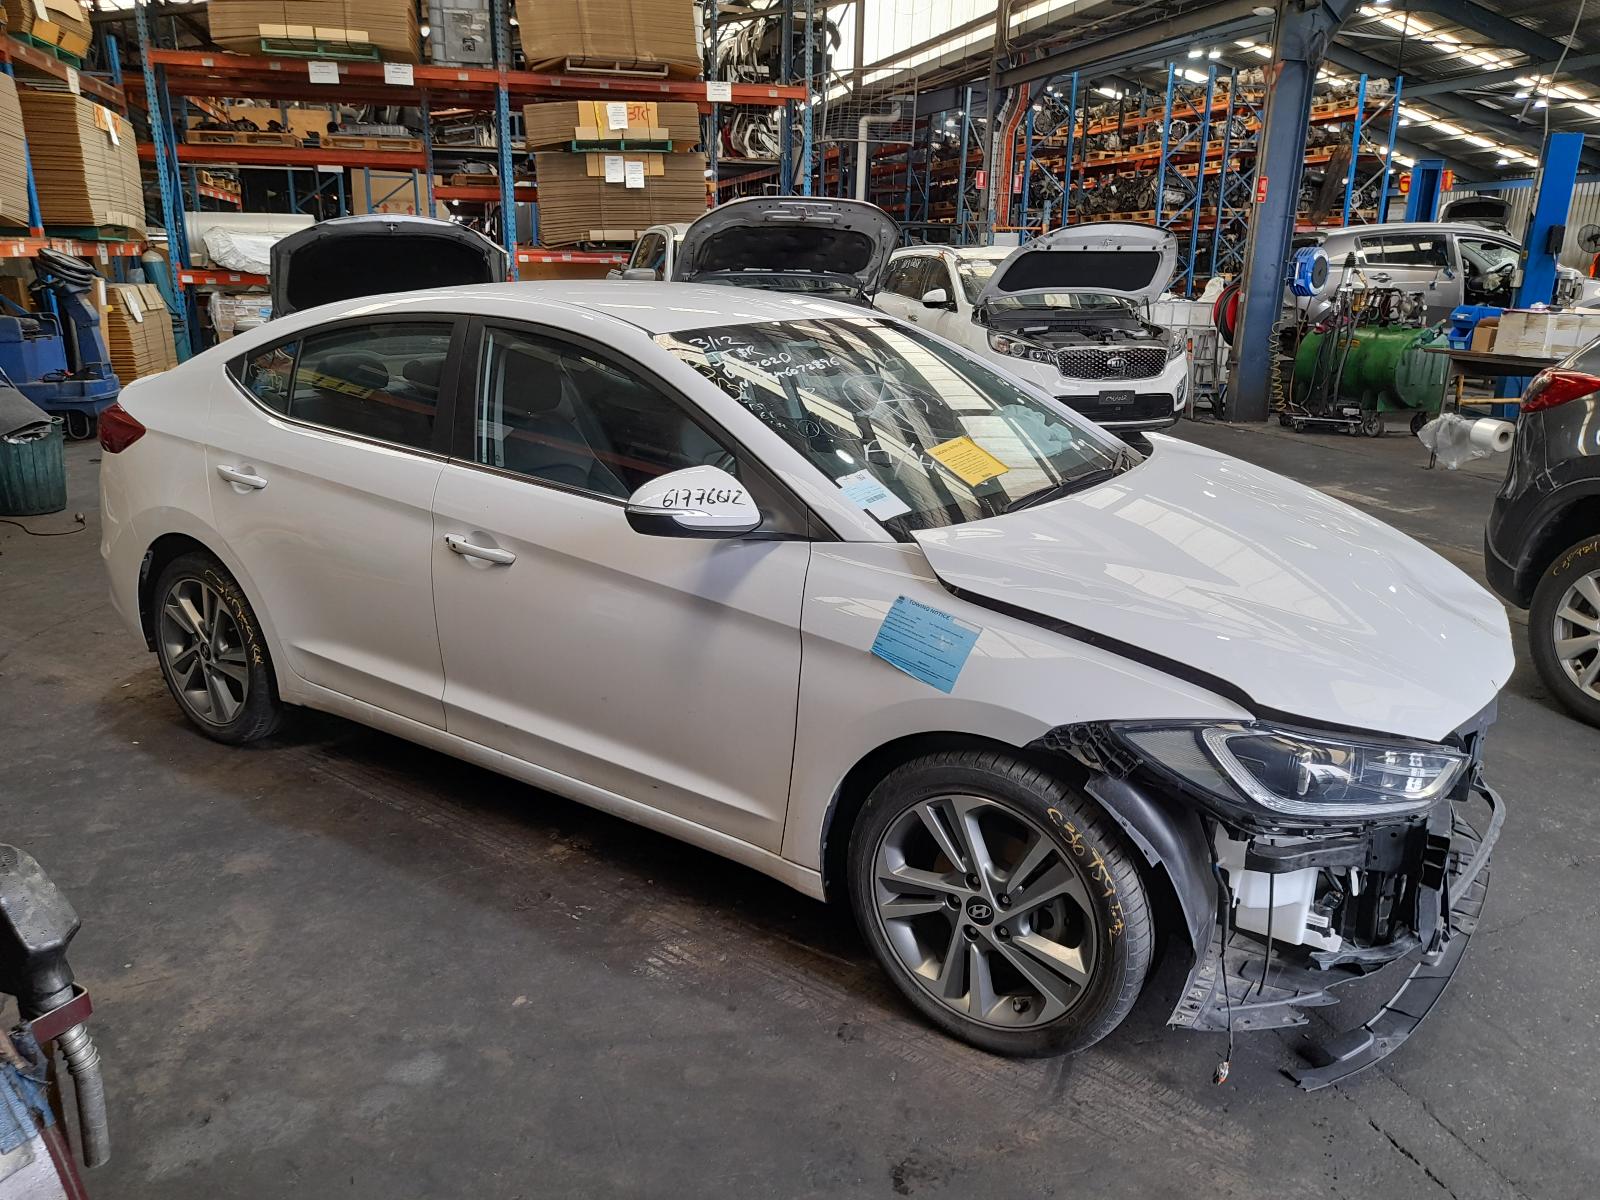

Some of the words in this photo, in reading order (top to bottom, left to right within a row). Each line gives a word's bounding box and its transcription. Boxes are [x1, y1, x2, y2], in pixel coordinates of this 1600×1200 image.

[1111, 360, 1125, 368] KIA
[909, 600, 930, 612] TOWING
[930, 608, 951, 621] NOTICE
